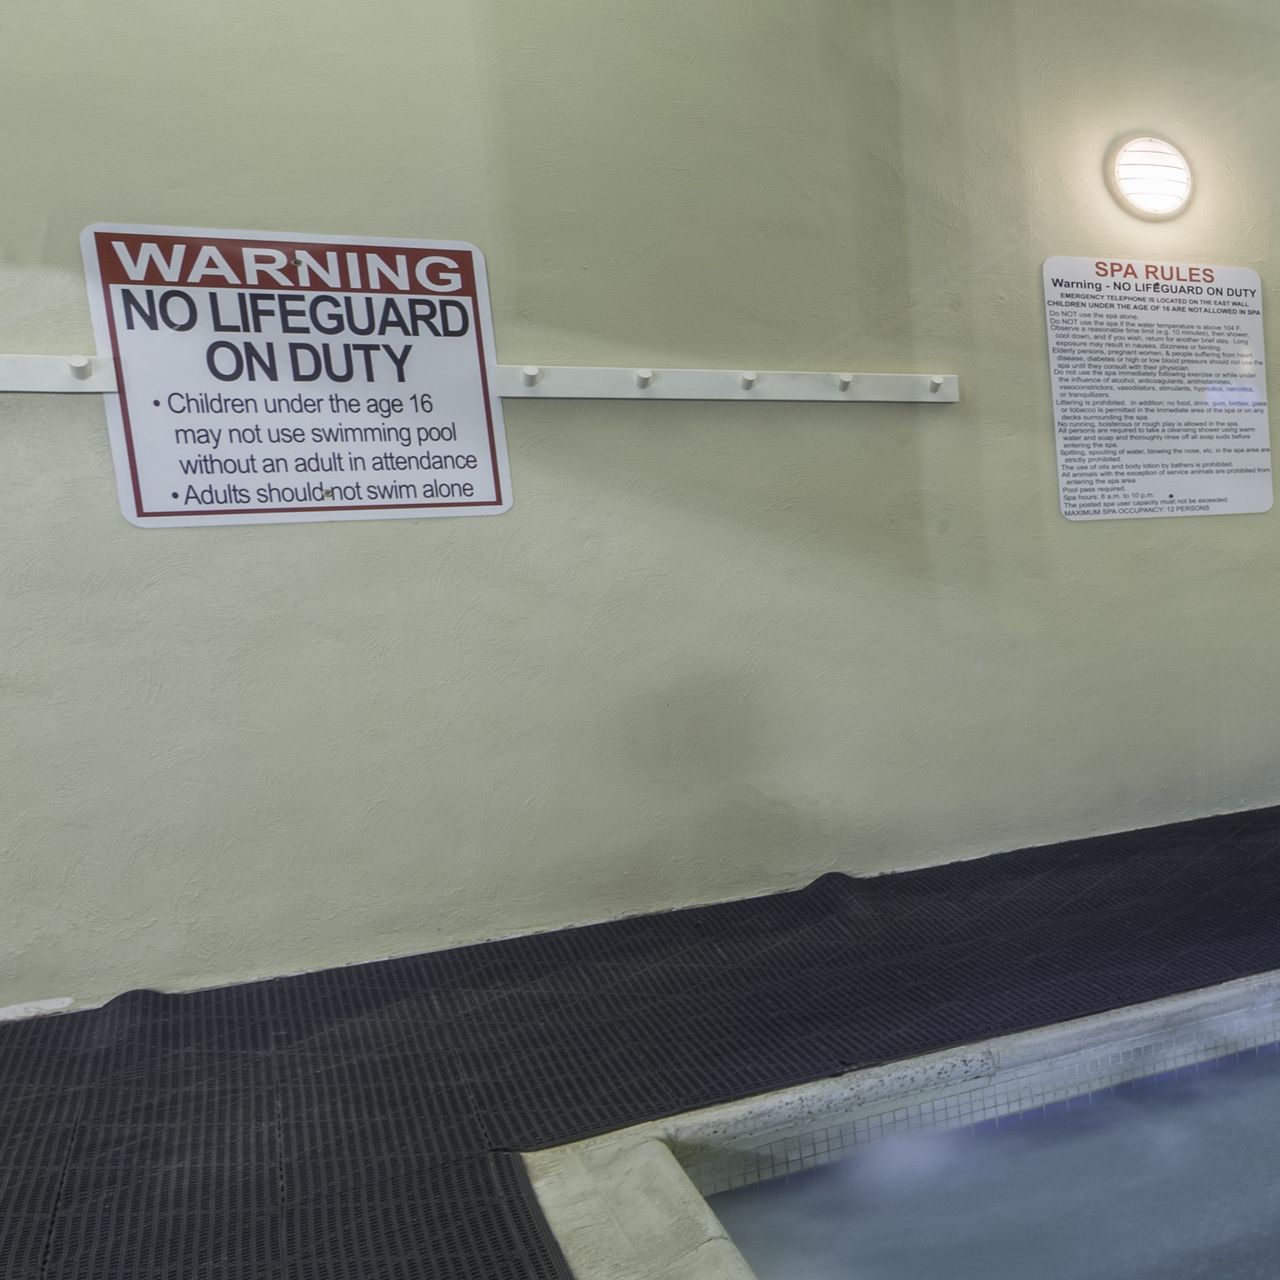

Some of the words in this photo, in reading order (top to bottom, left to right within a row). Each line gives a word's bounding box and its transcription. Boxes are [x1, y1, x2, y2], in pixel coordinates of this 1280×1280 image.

[111, 241, 463, 292] WARNING
[1095, 262, 1138, 278] SPA
[1145, 265, 1215, 283] RULES
[1051, 278, 1102, 292] Warning
[1113, 282, 1131, 291] NO
[1135, 283, 1203, 295] LIFEGUARD
[1206, 287, 1223, 296] ON
[1226, 288, 1257, 297] DUTY
[121, 288, 198, 332] NO
[208, 291, 470, 338] LIFEGUARD
[206, 340, 280, 383] ON
[288, 342, 413, 383] DUTY
[167, 392, 258, 414] Children
[264, 394, 324, 414] under
[328, 393, 361, 414] the
[366, 398, 404, 418] age
[409, 393, 433, 413] 16
[174, 428, 222, 449] may
[228, 424, 263, 443] not
[267, 427, 306, 443] use
[311, 422, 412, 447] swimming
[416, 422, 457, 446] pool
[178, 454, 258, 475] without
[262, 457, 289, 473] an
[295, 452, 345, 472] adult
[348, 452, 366, 471] in
[371, 451, 478, 471] attendance
[184, 484, 251, 505] Adults
[256, 482, 325, 503] should
[330, 482, 363, 501] not
[367, 480, 418, 500] swim
[422, 479, 474, 498] alone
